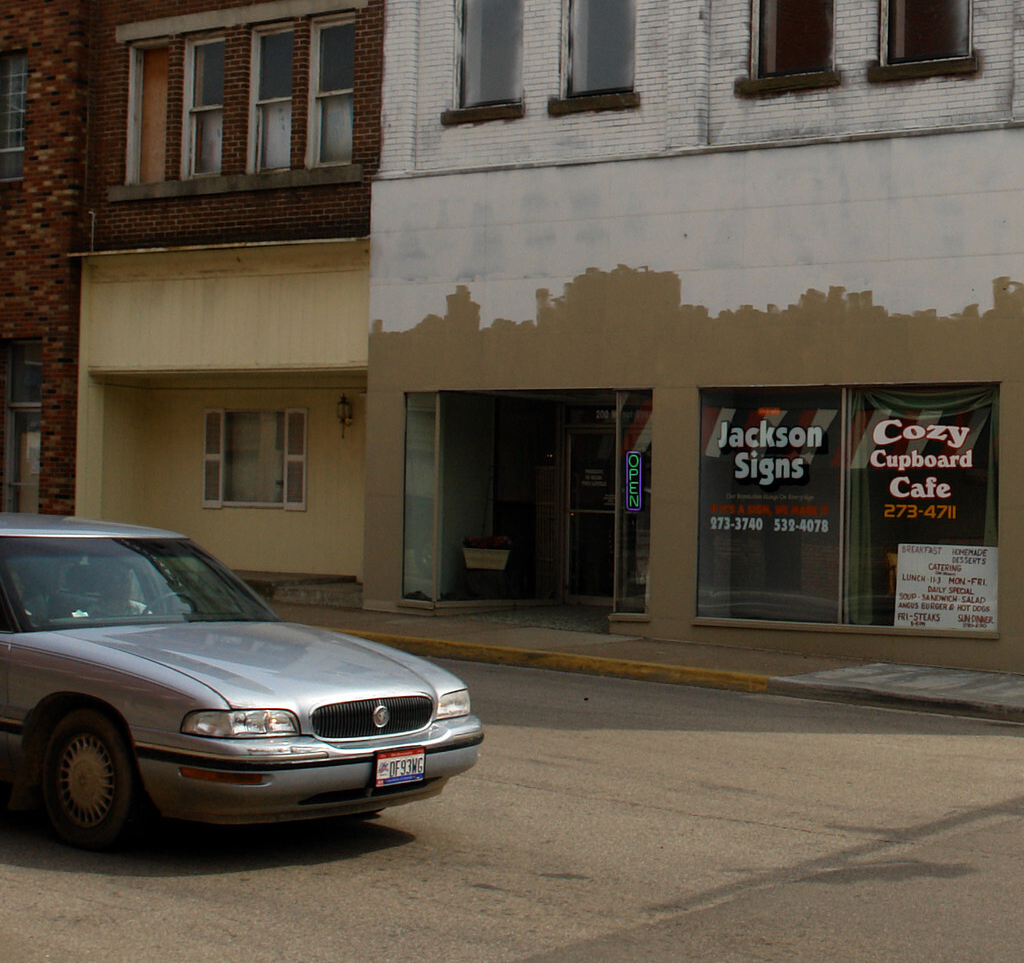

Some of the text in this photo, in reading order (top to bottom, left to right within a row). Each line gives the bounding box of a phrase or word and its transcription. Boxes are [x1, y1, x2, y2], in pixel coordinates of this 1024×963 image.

[718, 419, 823, 448] Jackson
[872, 419, 970, 449] Cozy
[869, 448, 973, 471] Cupboard
[734, 450, 804, 486] Signs
[628, 454, 639, 507] OPEN
[889, 475, 952, 498] Cafe
[738, 505, 745, 514] A
[884, 504, 957, 519] 273-4711
[710, 516, 829, 533] 273-3740 532-4078
[902, 545, 988, 557] BREAKFAST HOMEMADE
[928, 562, 962, 572] CATERING
[952, 556, 987, 565] DESSERTS
[902, 573, 926, 582] LUNCH
[927, 585, 974, 595] DAILY SPECIAL
[899, 592, 986, 604] SOUP SANDWICH SALAD
[921, 602, 947, 611] BURGER
[957, 604, 971, 612] HOT
